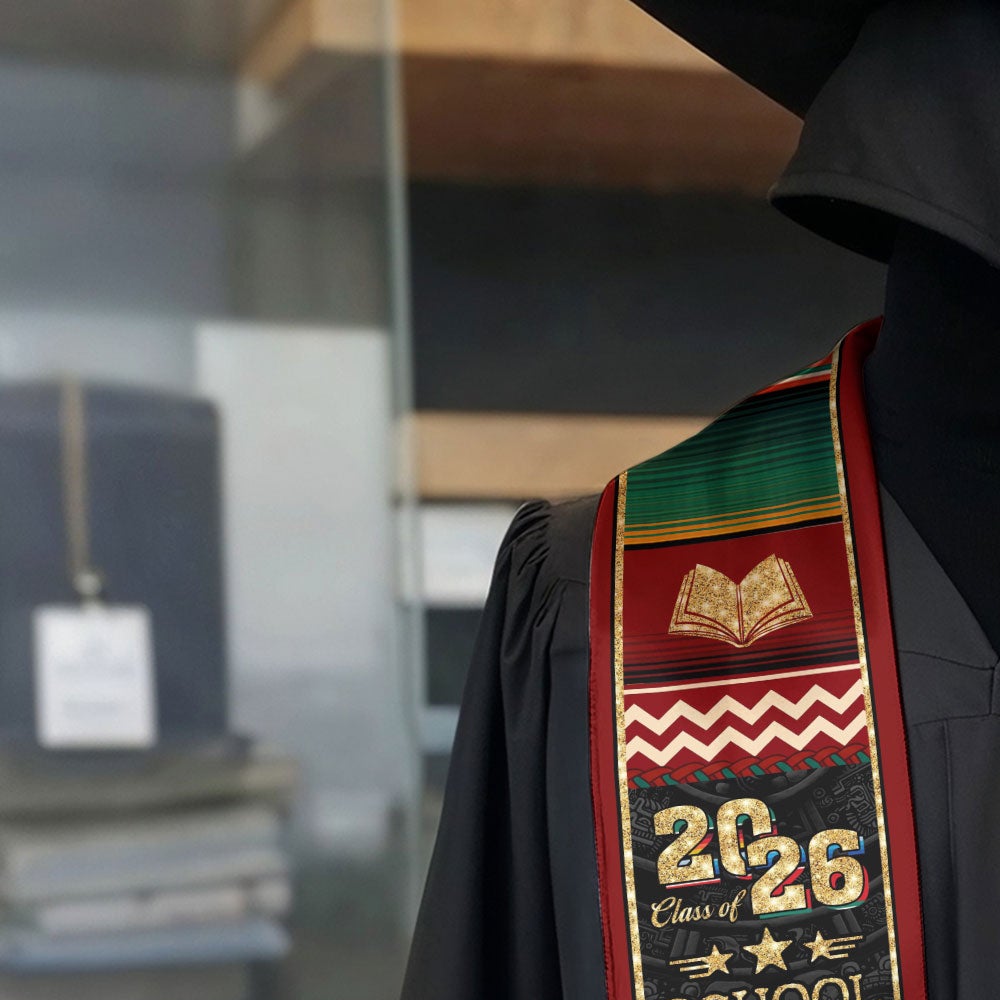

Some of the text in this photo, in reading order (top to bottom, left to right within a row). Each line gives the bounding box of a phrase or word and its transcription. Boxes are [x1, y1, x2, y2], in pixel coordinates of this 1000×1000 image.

[653, 797, 867, 917] 2026
[650, 888, 747, 928] Class of
